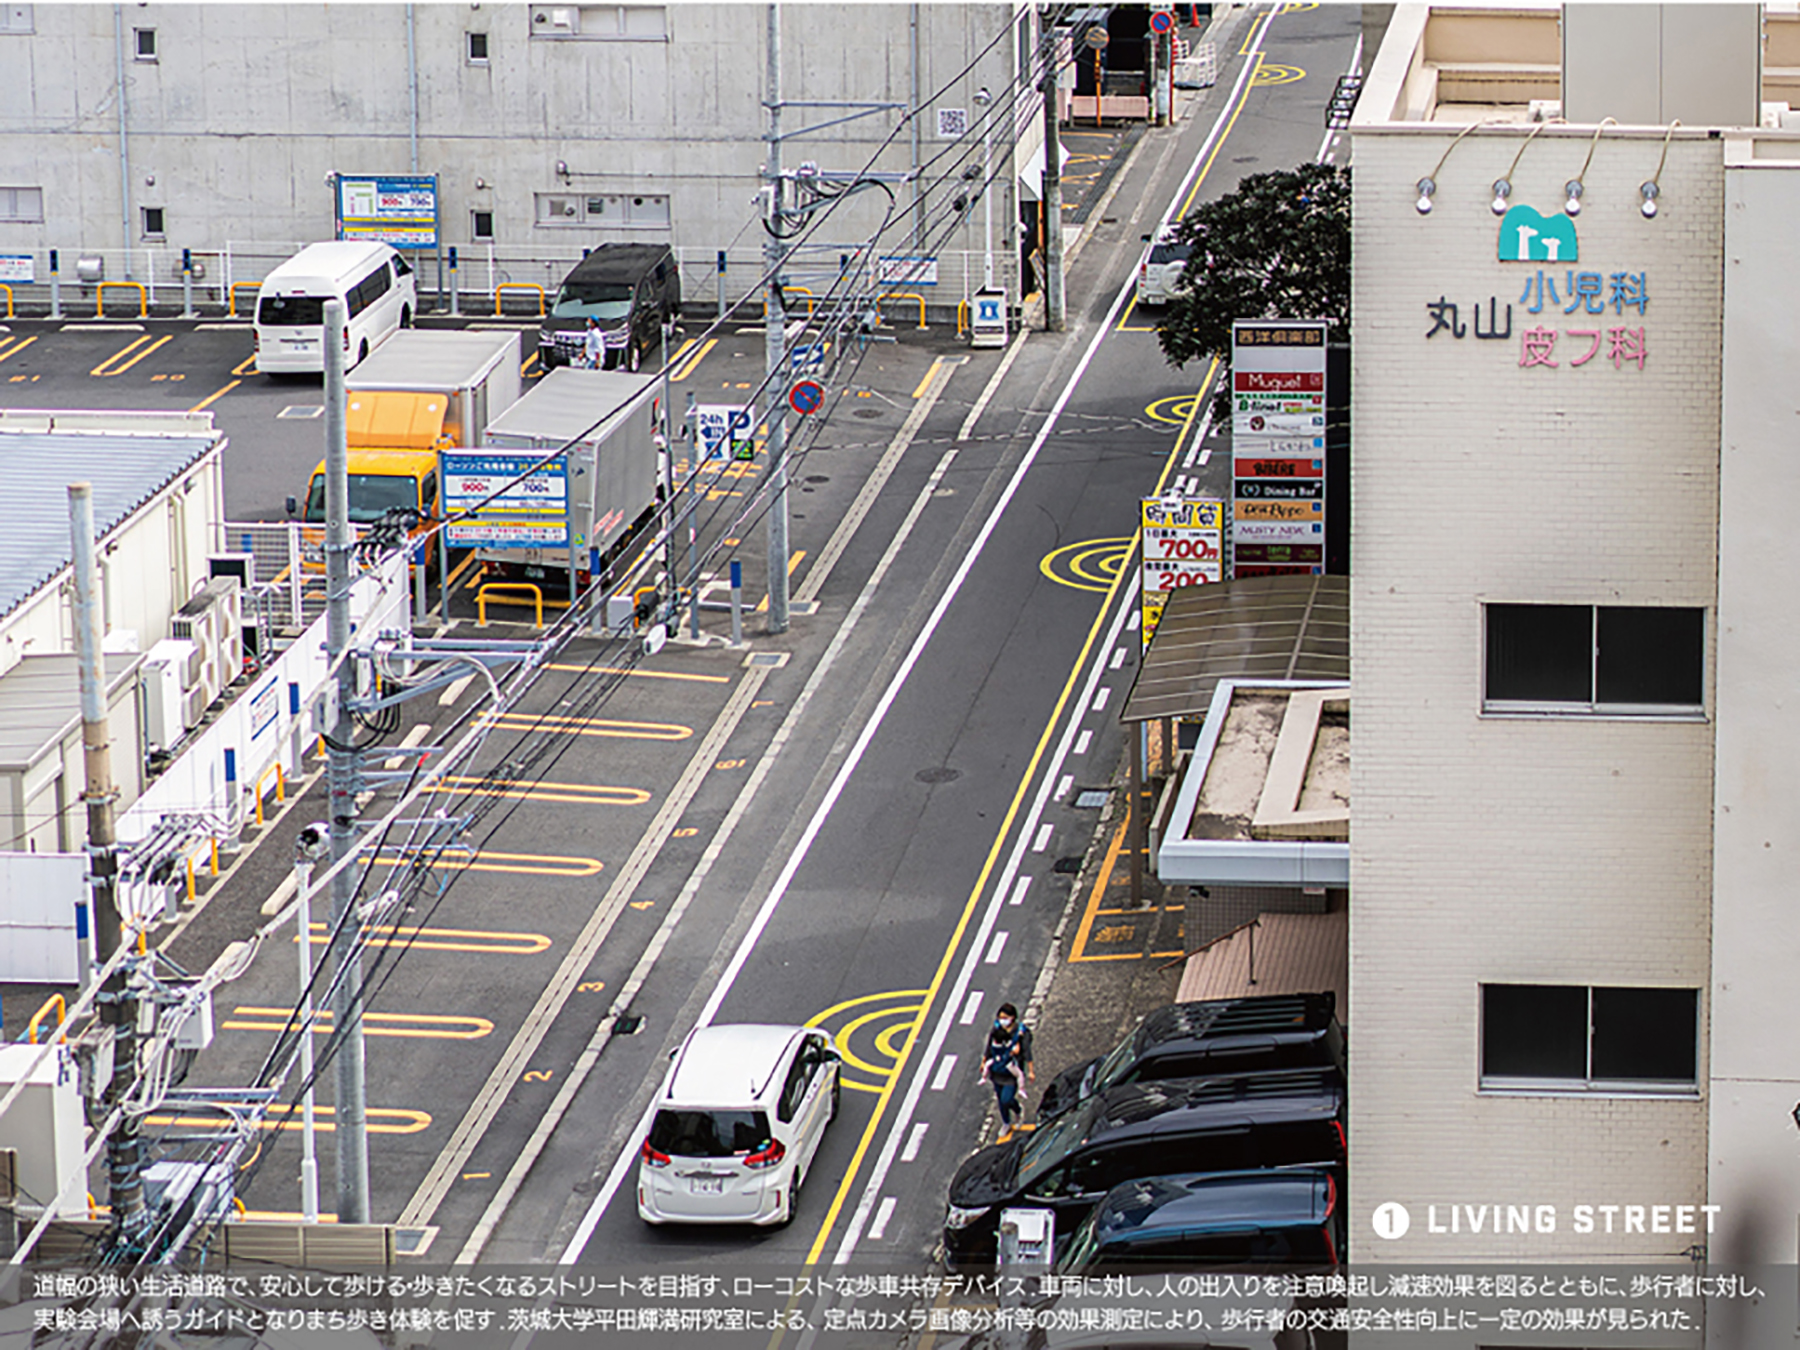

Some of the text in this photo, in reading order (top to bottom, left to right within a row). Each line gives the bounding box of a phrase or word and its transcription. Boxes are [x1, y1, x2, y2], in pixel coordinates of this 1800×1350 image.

[1519, 270, 1649, 315] 小児科
[1425, 296, 1512, 339] 丸山
[1518, 325, 1648, 369] 皮フ科
[700, 414, 723, 424] 24h
[728, 411, 751, 440] P
[1159, 539, 1218, 559] 700円
[672, 827, 699, 838] 5
[577, 981, 605, 994] 3
[524, 1069, 553, 1082] 2
[463, 1172, 492, 1181] 1
